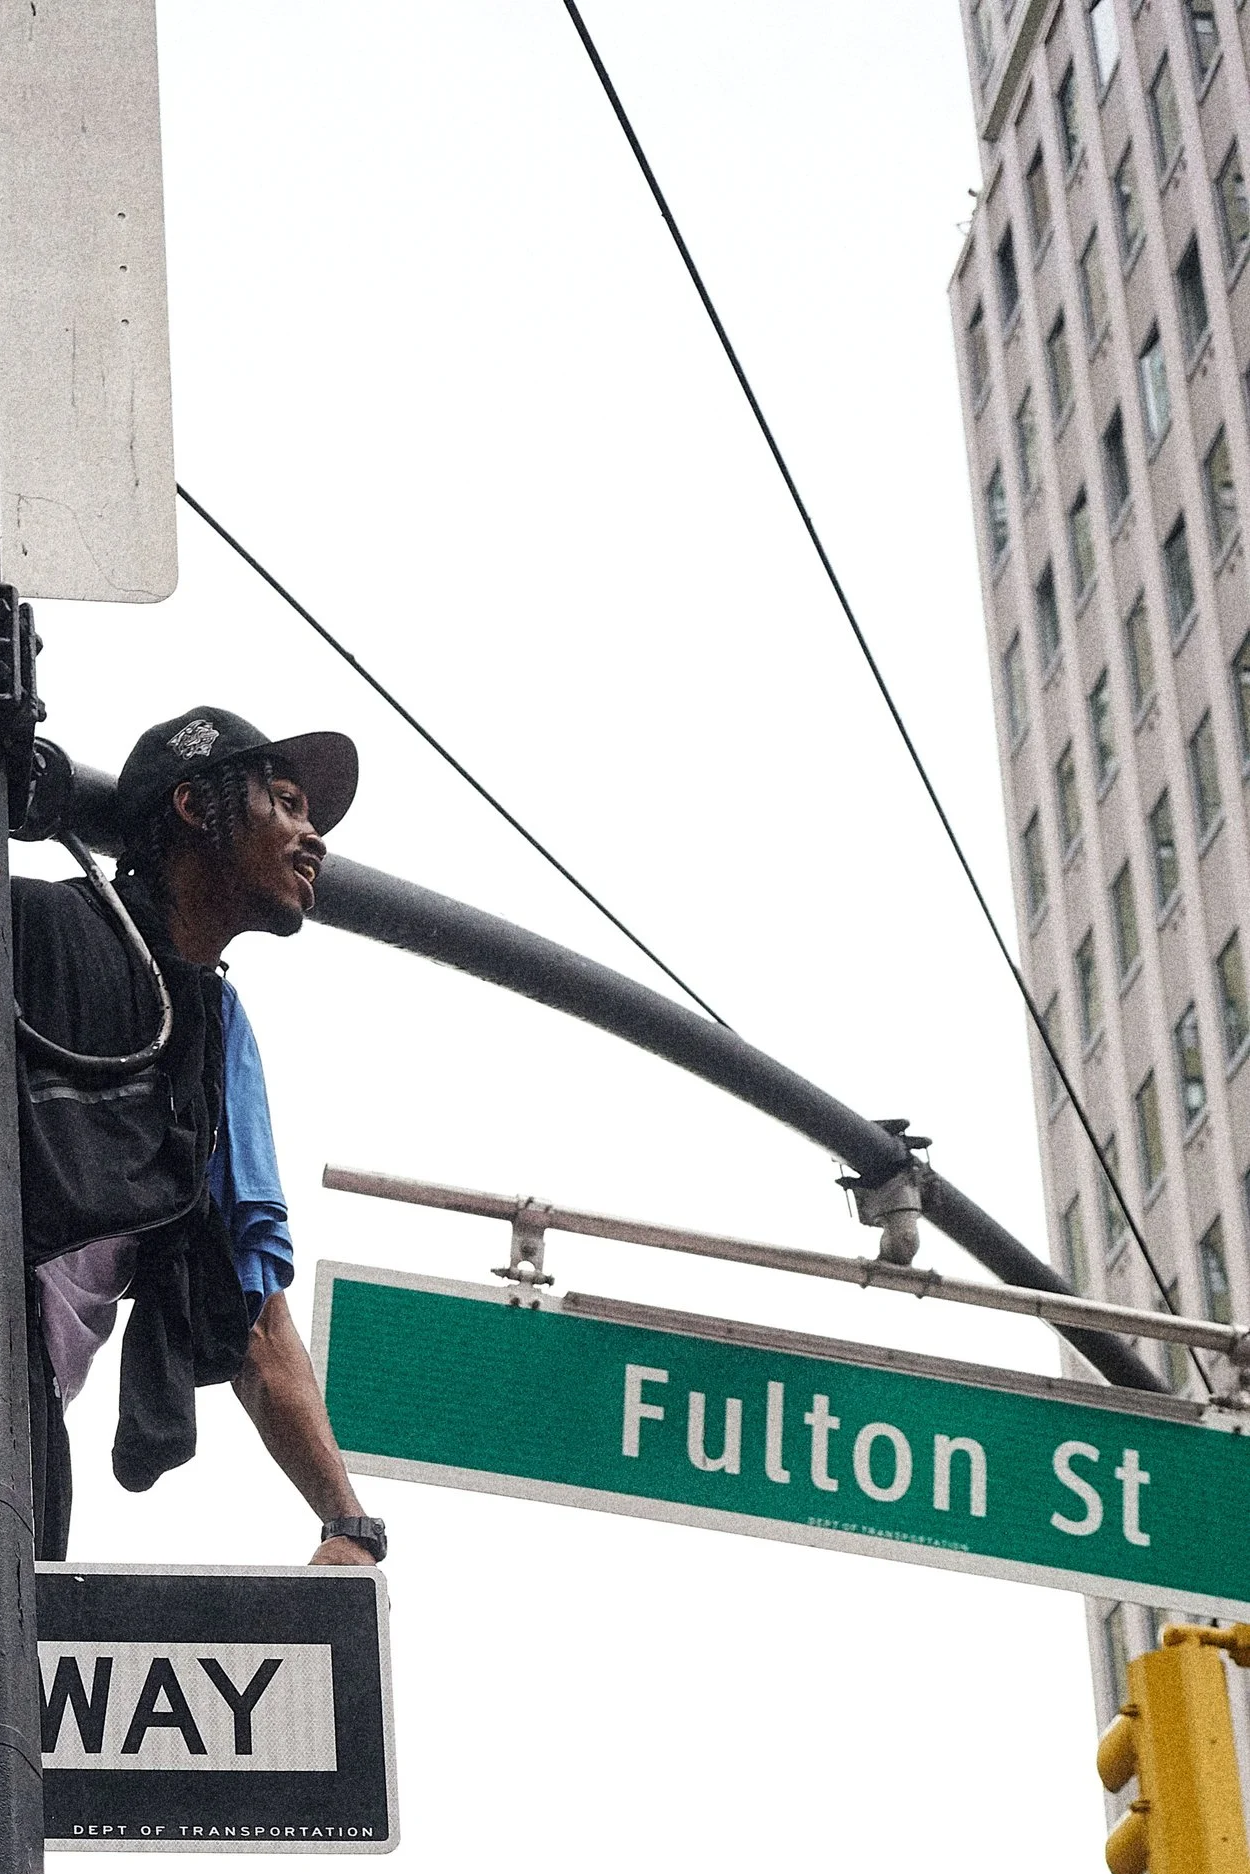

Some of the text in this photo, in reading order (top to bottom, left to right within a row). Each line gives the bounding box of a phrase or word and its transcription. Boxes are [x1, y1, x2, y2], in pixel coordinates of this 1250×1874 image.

[622, 1364, 1150, 1547] Fulton St
[808, 1516, 839, 1529] DEPT
[861, 1525, 969, 1551] TRANSPORTATION
[40, 1656, 283, 1756] WAY
[73, 1824, 375, 1837] DEPT OF TRANSPORTATION
